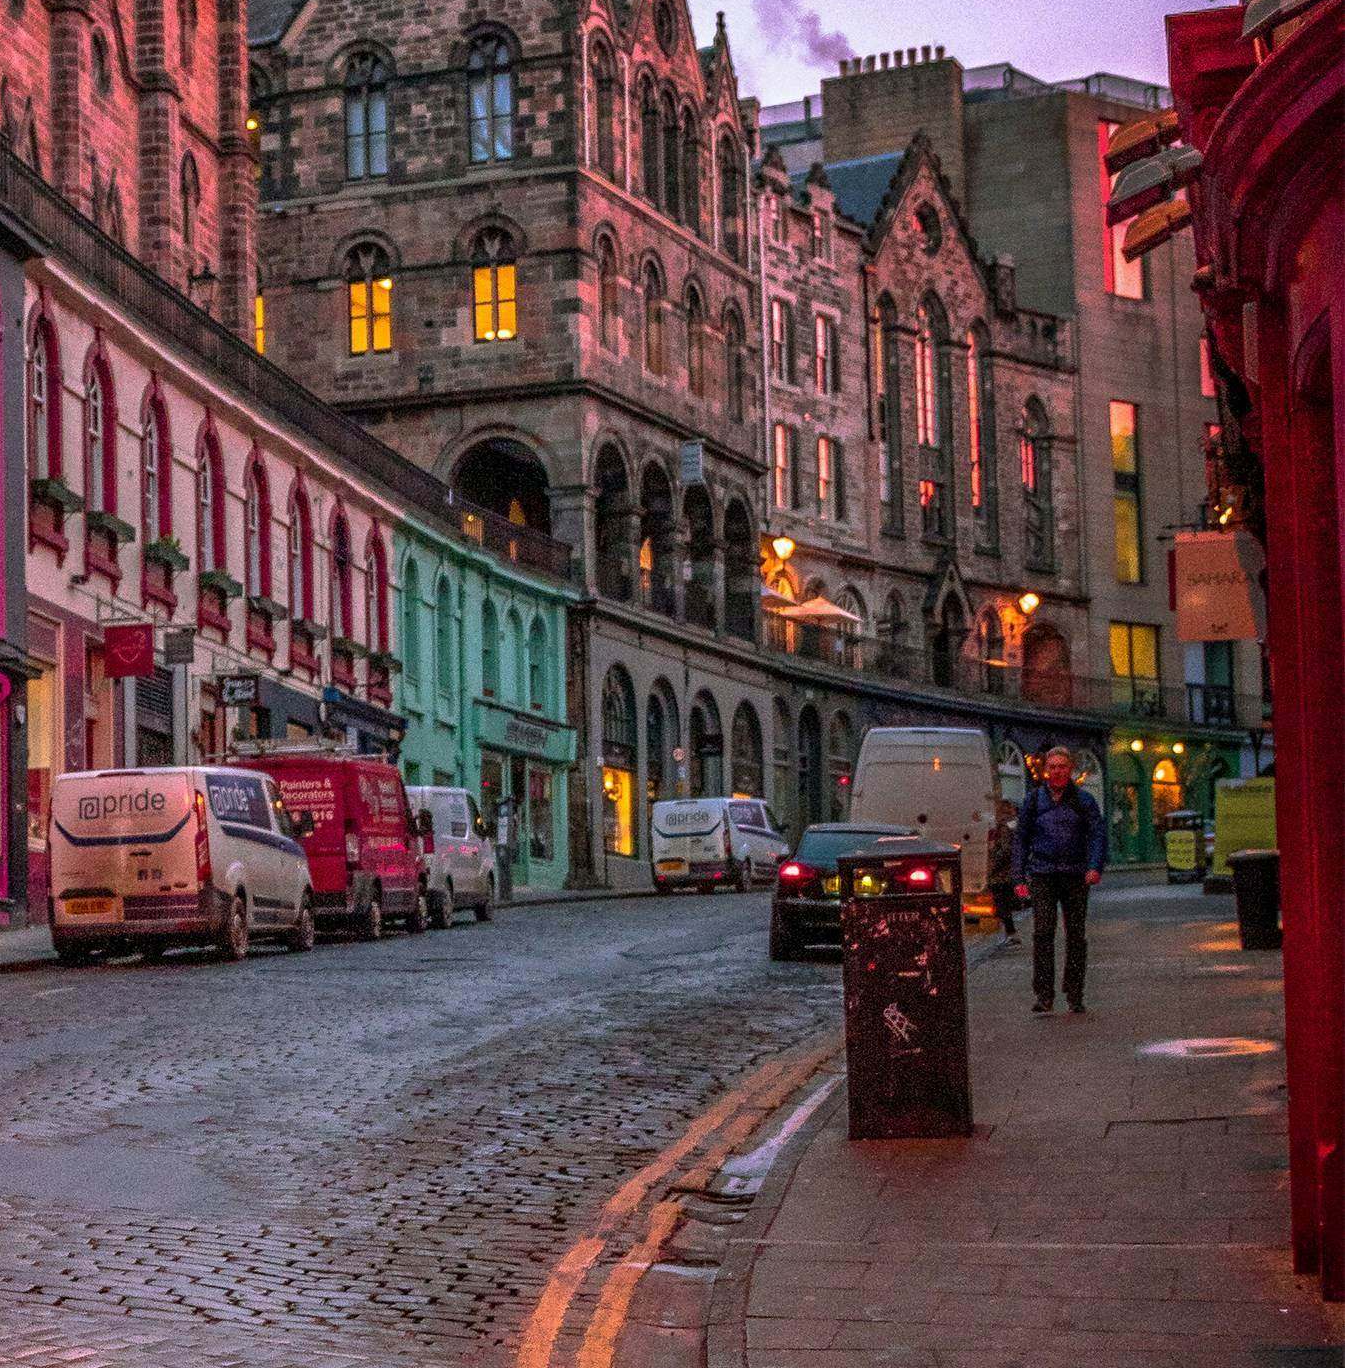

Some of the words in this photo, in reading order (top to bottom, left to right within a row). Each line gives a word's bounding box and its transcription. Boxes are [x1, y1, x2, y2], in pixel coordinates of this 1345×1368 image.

[280, 779, 322, 790] Painters
[324, 778, 332, 788] &
[103, 787, 166, 820] pride
